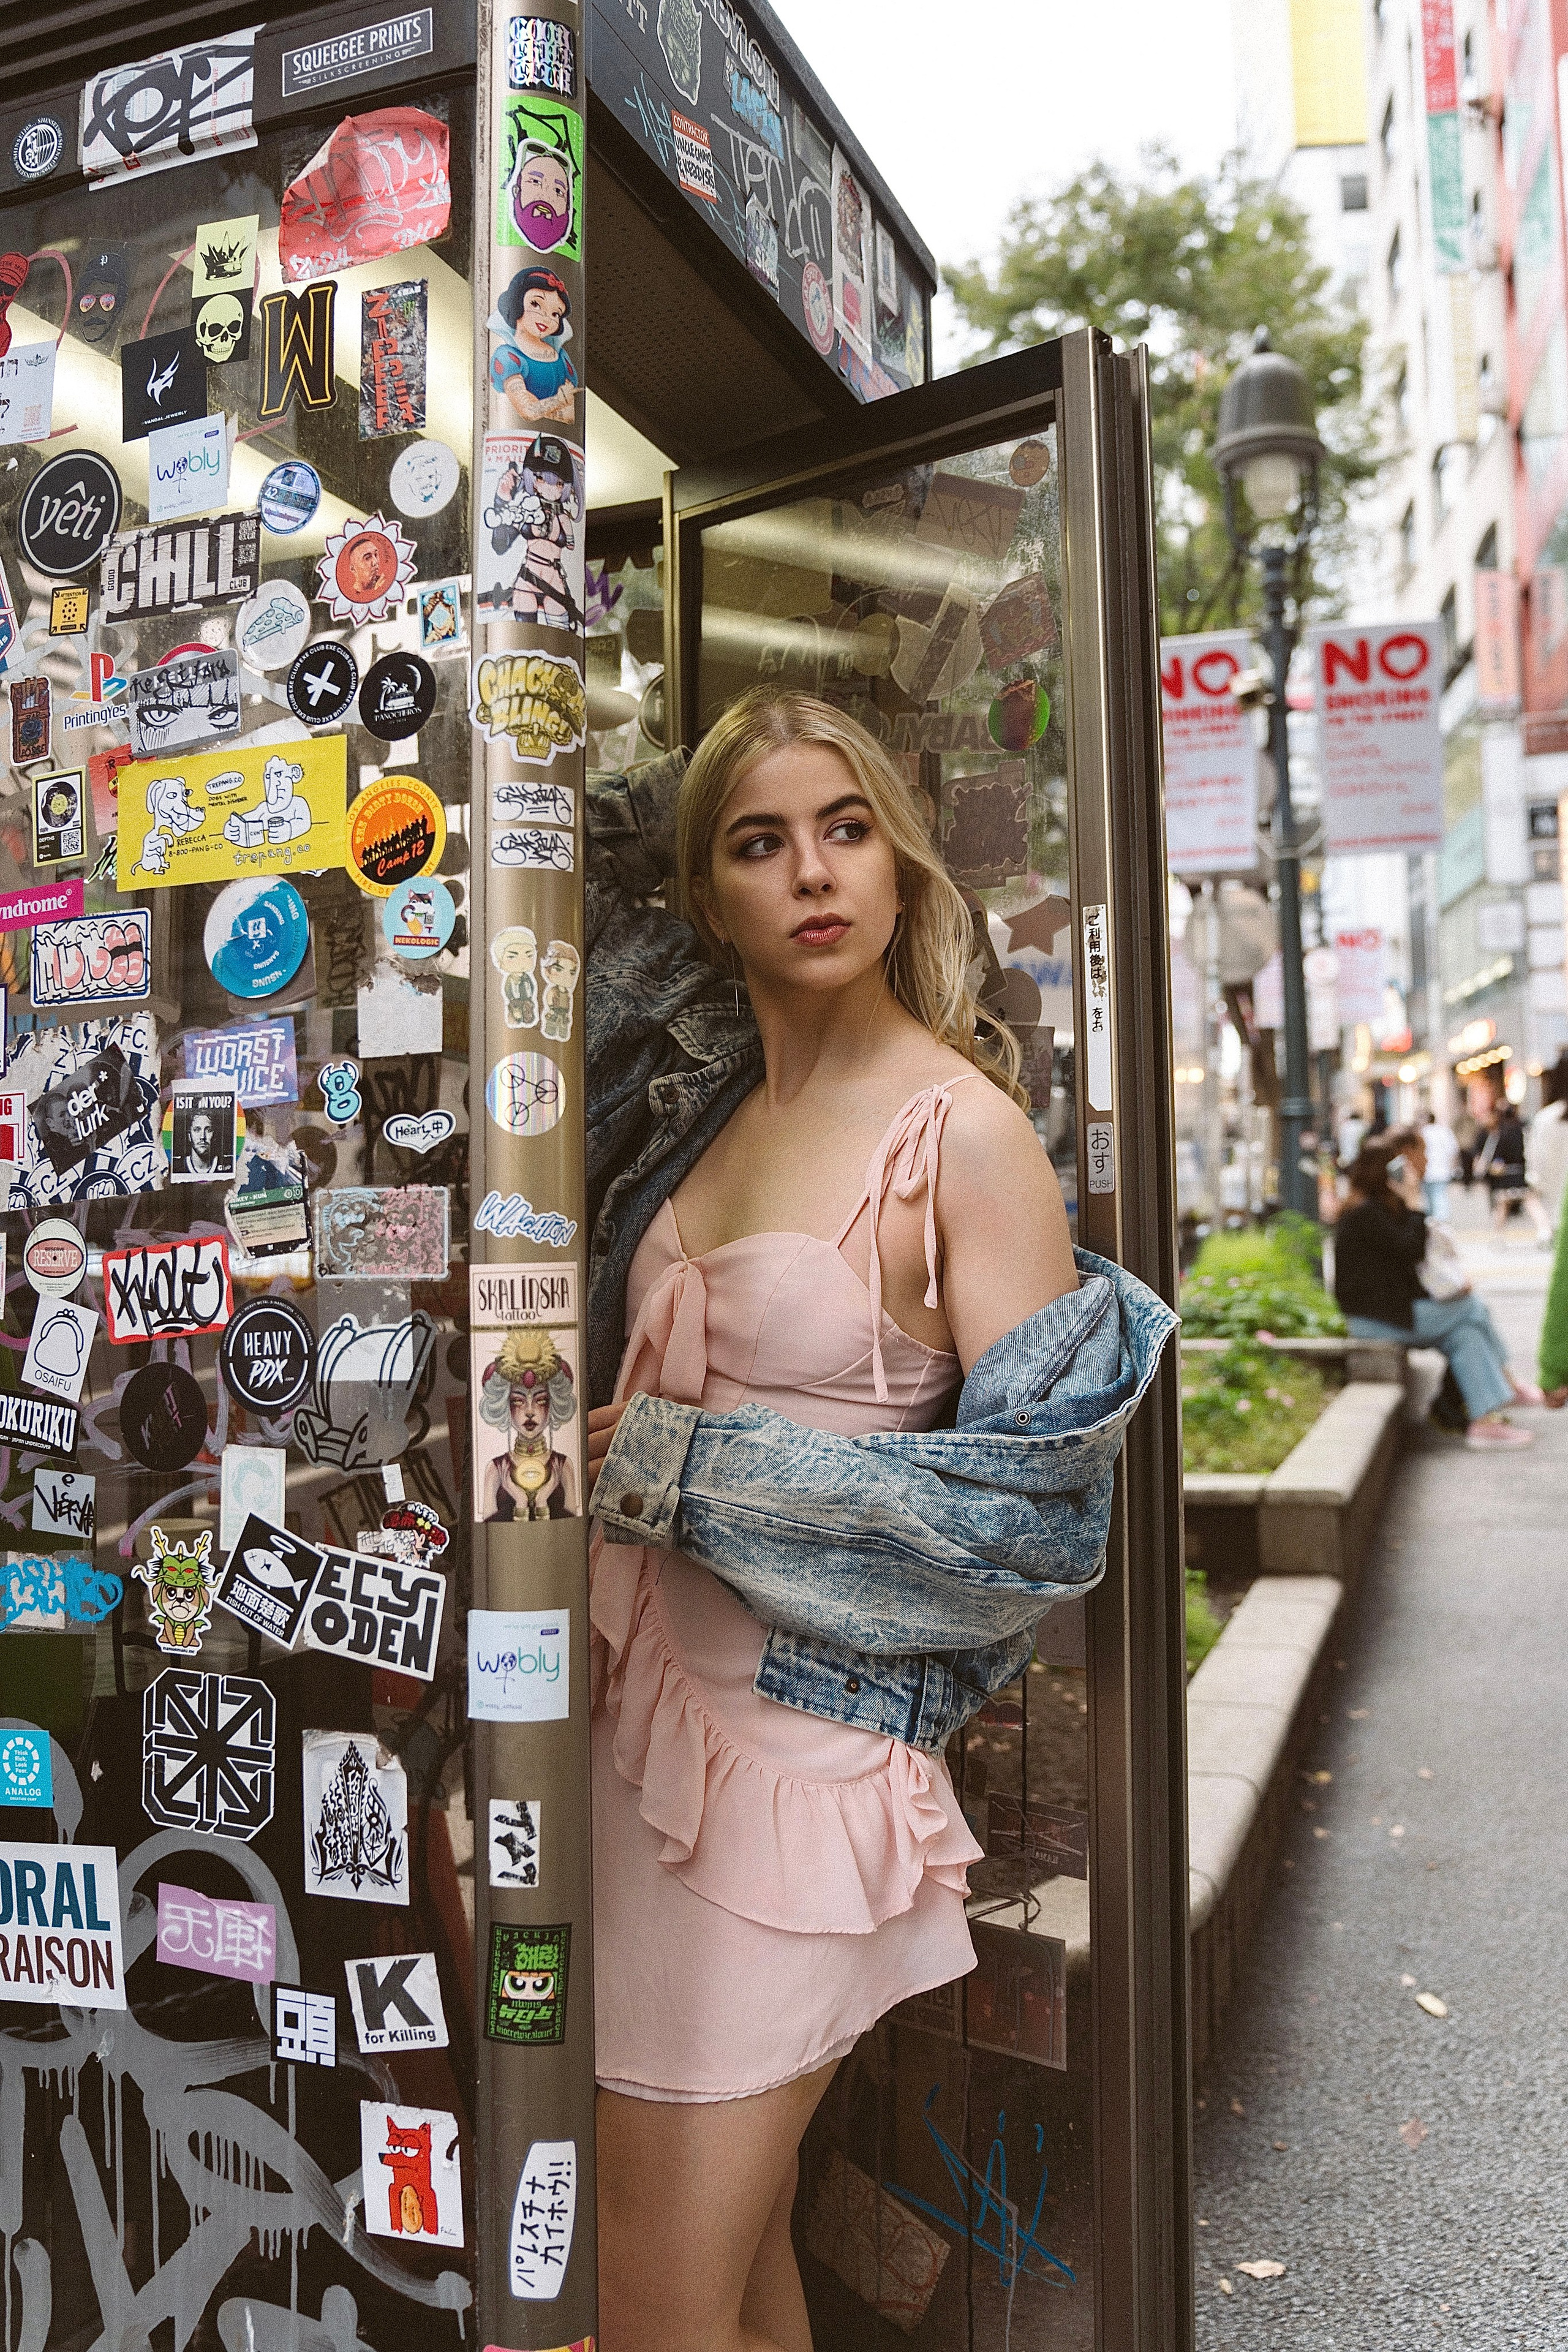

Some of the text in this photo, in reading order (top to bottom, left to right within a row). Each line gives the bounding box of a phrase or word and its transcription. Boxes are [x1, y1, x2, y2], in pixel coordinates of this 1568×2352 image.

[293, 17, 421, 75] SQUEEGEE PRINTS
[312, 51, 400, 82] SILKSCREENING
[674, 115, 709, 146] CONTRACTOR
[102, 523, 235, 614] CHILL
[107, 568, 116, 592] GOOD
[229, 578, 247, 591] CLUB
[1321, 632, 1430, 685] NO
[64, 705, 127, 729] PrintingYes
[208, 775, 243, 790] TREPANG.CO
[347, 779, 440, 825] LOS ANGELES COUNTY
[176, 836, 206, 846] REBECCA
[235, 844, 311, 869] trepang.co
[377, 839, 425, 877] Camp 12
[355, 873, 372, 890] FIRE
[263, 900, 285, 925] SAMSUNG
[394, 937, 439, 946] NEKOLOGIC
[253, 950, 280, 970] SAMSUNG
[195, 1033, 286, 1074] WORST
[209, 1096, 233, 1108] YOU?
[74, 1103, 110, 1142] lurk
[396, 1124, 426, 1139] Heart
[1091, 1129, 1109, 1175] おす
[33, 1249, 78, 1268] RESERVE
[500, 1308, 537, 1321] tattoo
[243, 1331, 292, 1357] HEAVY
[34, 1369, 72, 1393] OSAIFU
[248, 1358, 288, 1390] PDX
[24, 1439, 53, 1450] UNDERCOVER
[225, 1596, 285, 1638] FISH OUT OF WATER
[311, 1596, 437, 1673] ODEN
[5, 1787, 42, 1796] ANALOG
[356, 1958, 434, 2032] K
[365, 2028, 437, 2045] for Killing
